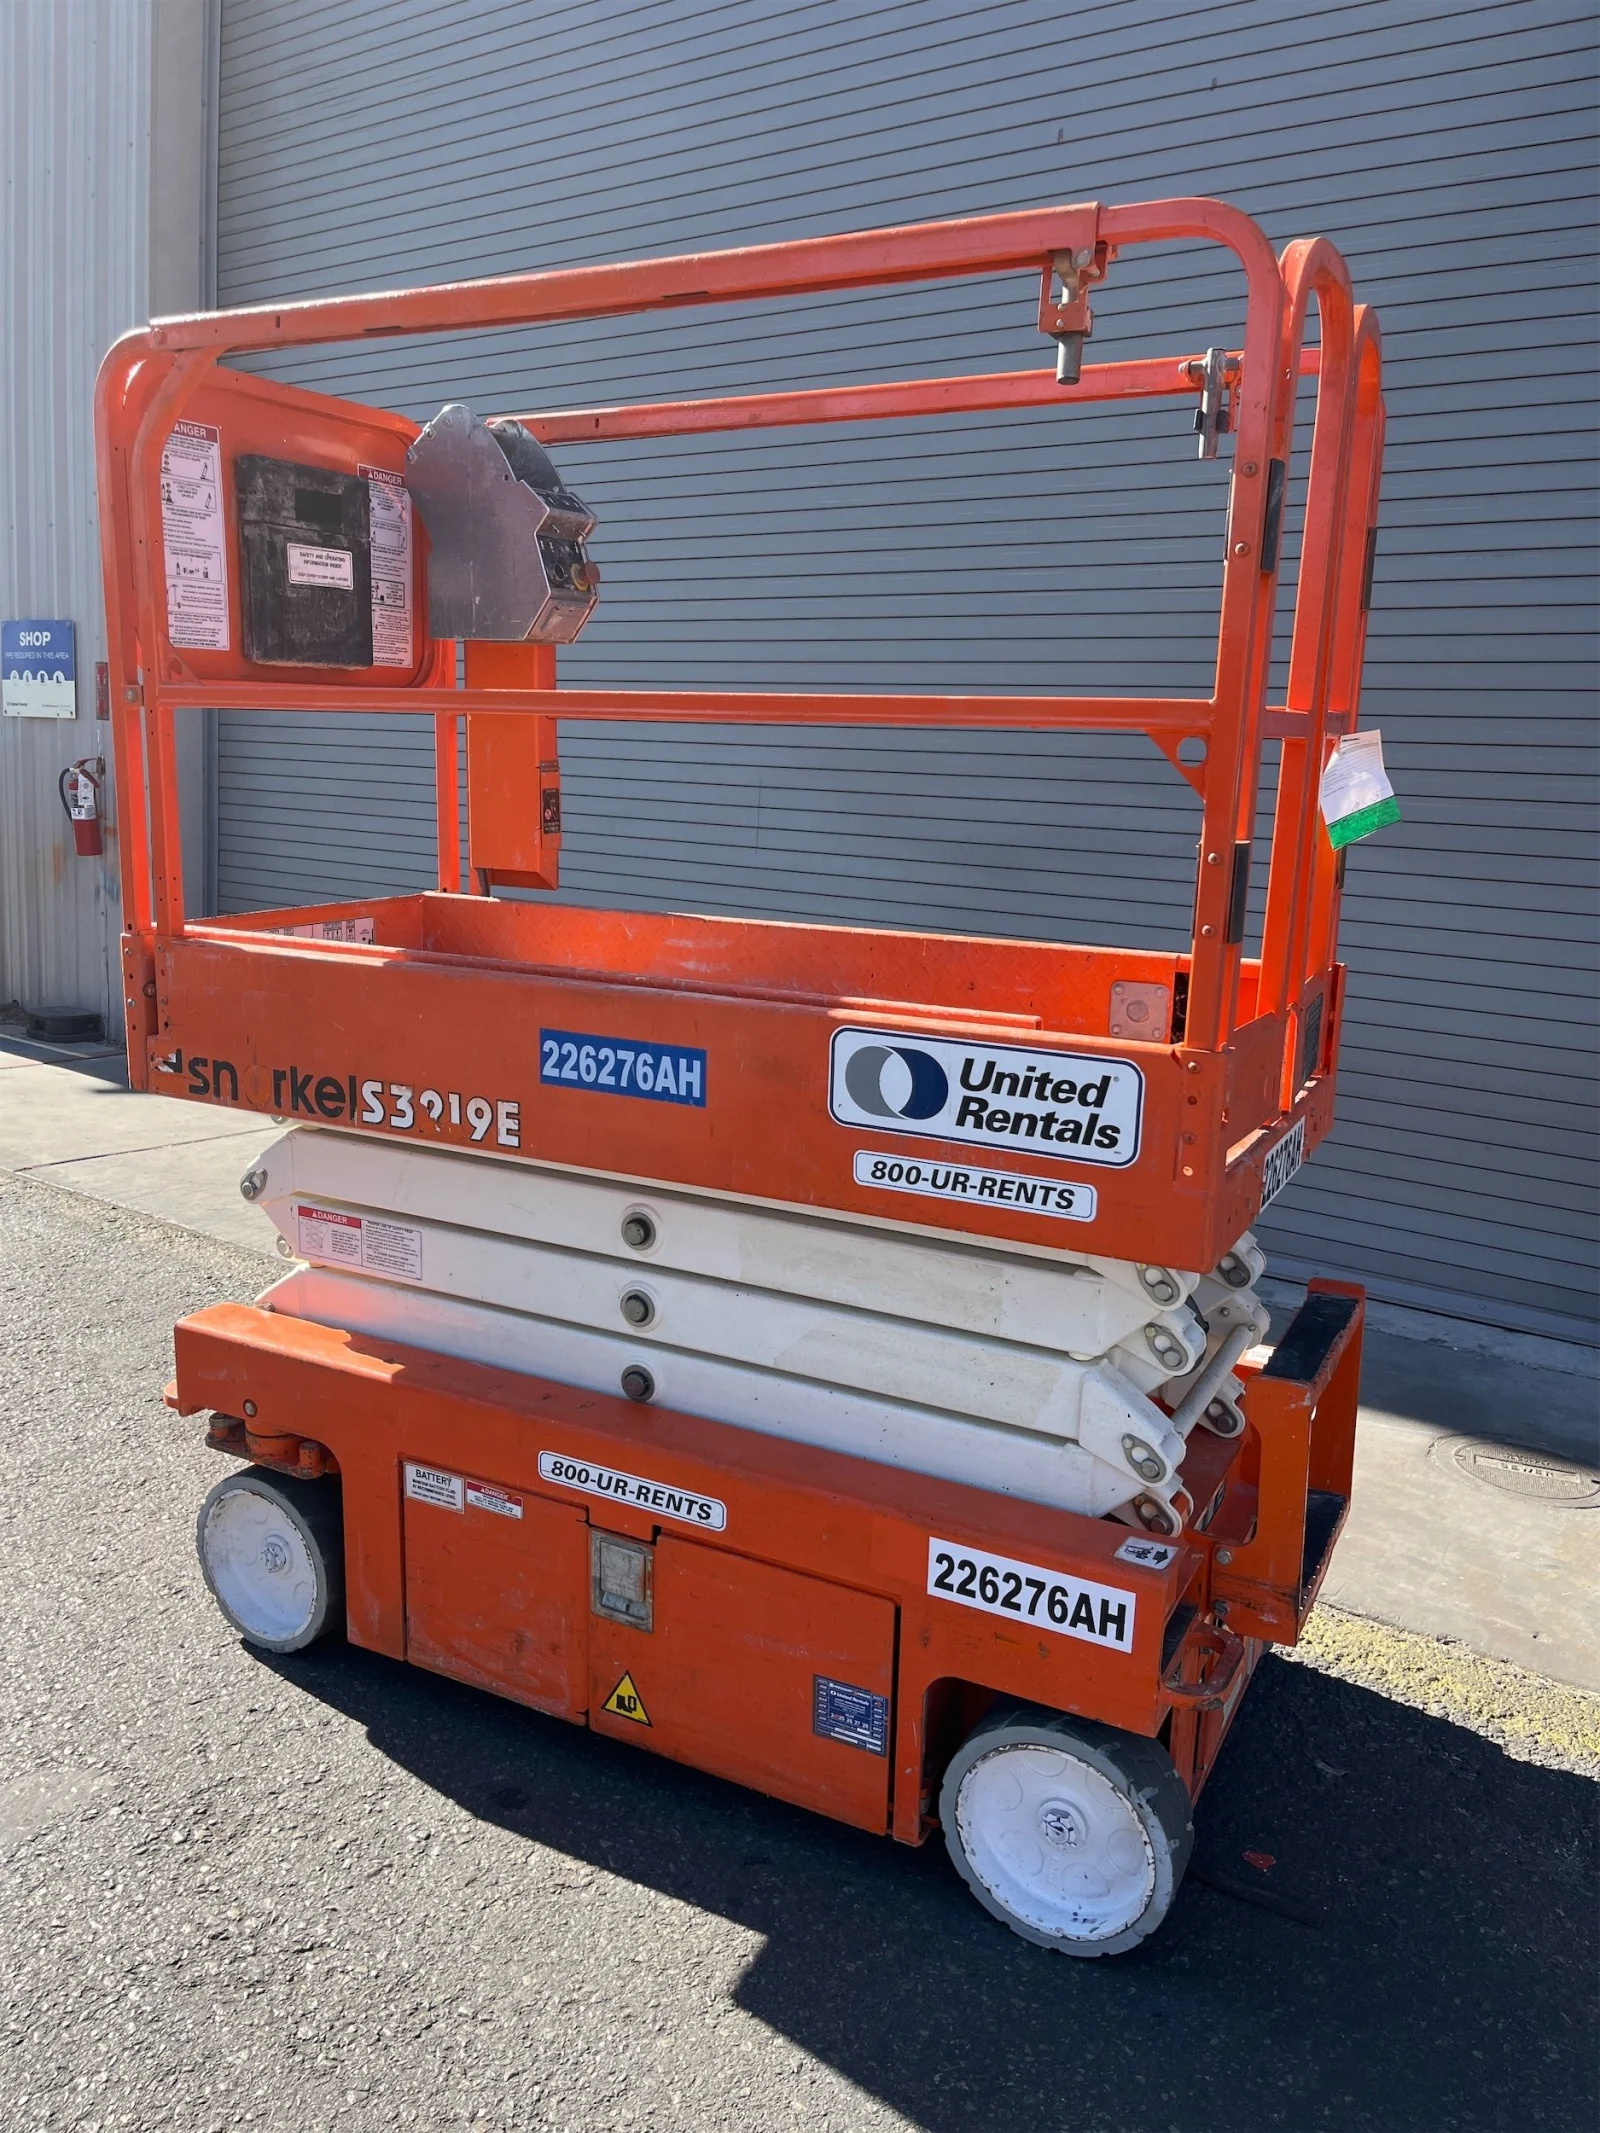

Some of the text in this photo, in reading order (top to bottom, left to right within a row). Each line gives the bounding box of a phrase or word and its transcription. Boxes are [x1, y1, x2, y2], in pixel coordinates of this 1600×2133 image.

[173, 422, 207, 439] ANGER
[373, 470, 403, 486] DANGER
[19, 631, 52, 647] SHOP
[542, 1039, 701, 1098] 226276AH
[188, 1055, 357, 1123] snrkel
[959, 1057, 1112, 1108] United
[955, 1095, 1121, 1149] Rentals
[870, 1160, 1075, 1210] 800-UR-RENTS
[316, 1212, 348, 1225] DANGER
[415, 1468, 453, 1487] BATTERY
[1500, 1462, 1554, 1477] SEWER
[484, 1487, 509, 1501] DANGER
[550, 1460, 712, 1521] 800-UR-RENTS
[933, 1552, 1127, 1642] 226276AH
[836, 1691, 853, 1701] United
[852, 1696, 870, 1706] Rentals
